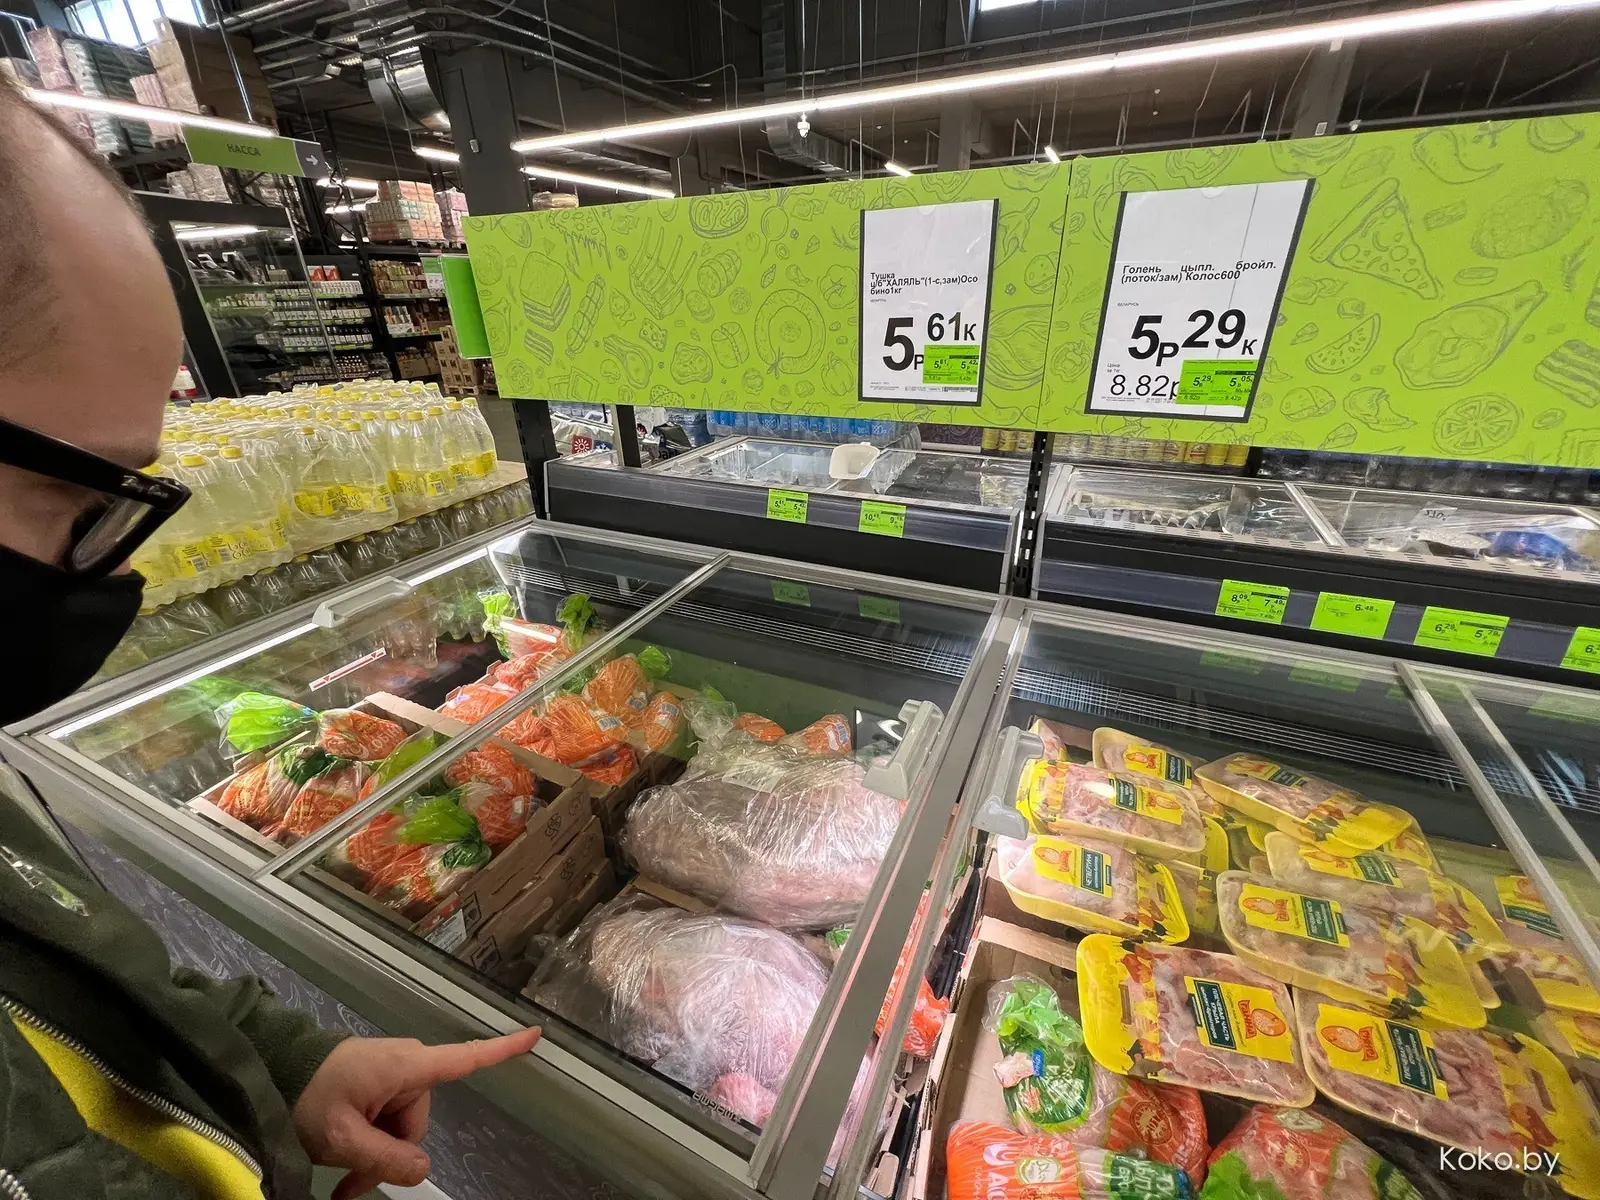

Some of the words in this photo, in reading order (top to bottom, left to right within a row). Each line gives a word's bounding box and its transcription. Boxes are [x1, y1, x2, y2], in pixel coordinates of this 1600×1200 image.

[1122, 265, 1162, 274] Голень
[1235, 259, 1277, 272] бройл.
[870, 272, 896, 281] Тушка
[1185, 270, 1241, 282] Колос600
